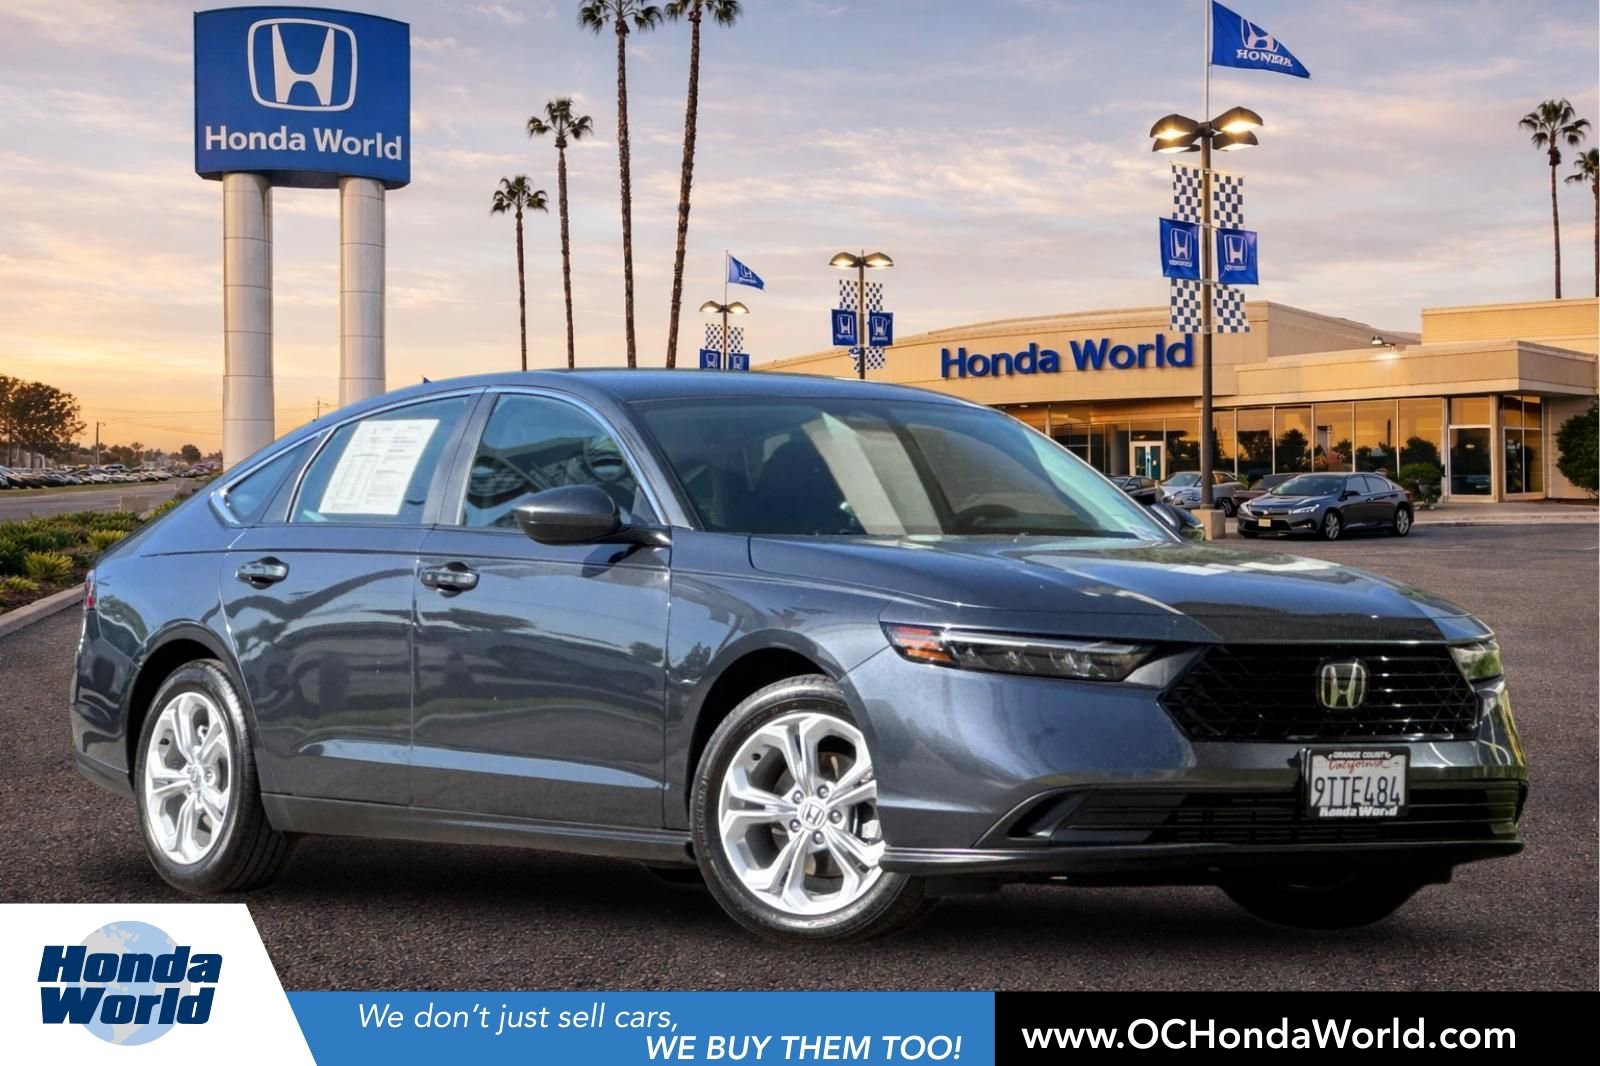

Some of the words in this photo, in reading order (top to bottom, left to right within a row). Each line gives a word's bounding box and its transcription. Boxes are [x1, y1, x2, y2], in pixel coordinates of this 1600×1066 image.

[205, 125, 306, 151] Honda
[312, 127, 402, 161] World
[941, 343, 1061, 378] Honda
[1070, 333, 1194, 371] World
[1314, 776, 1400, 807] 9TTE484
